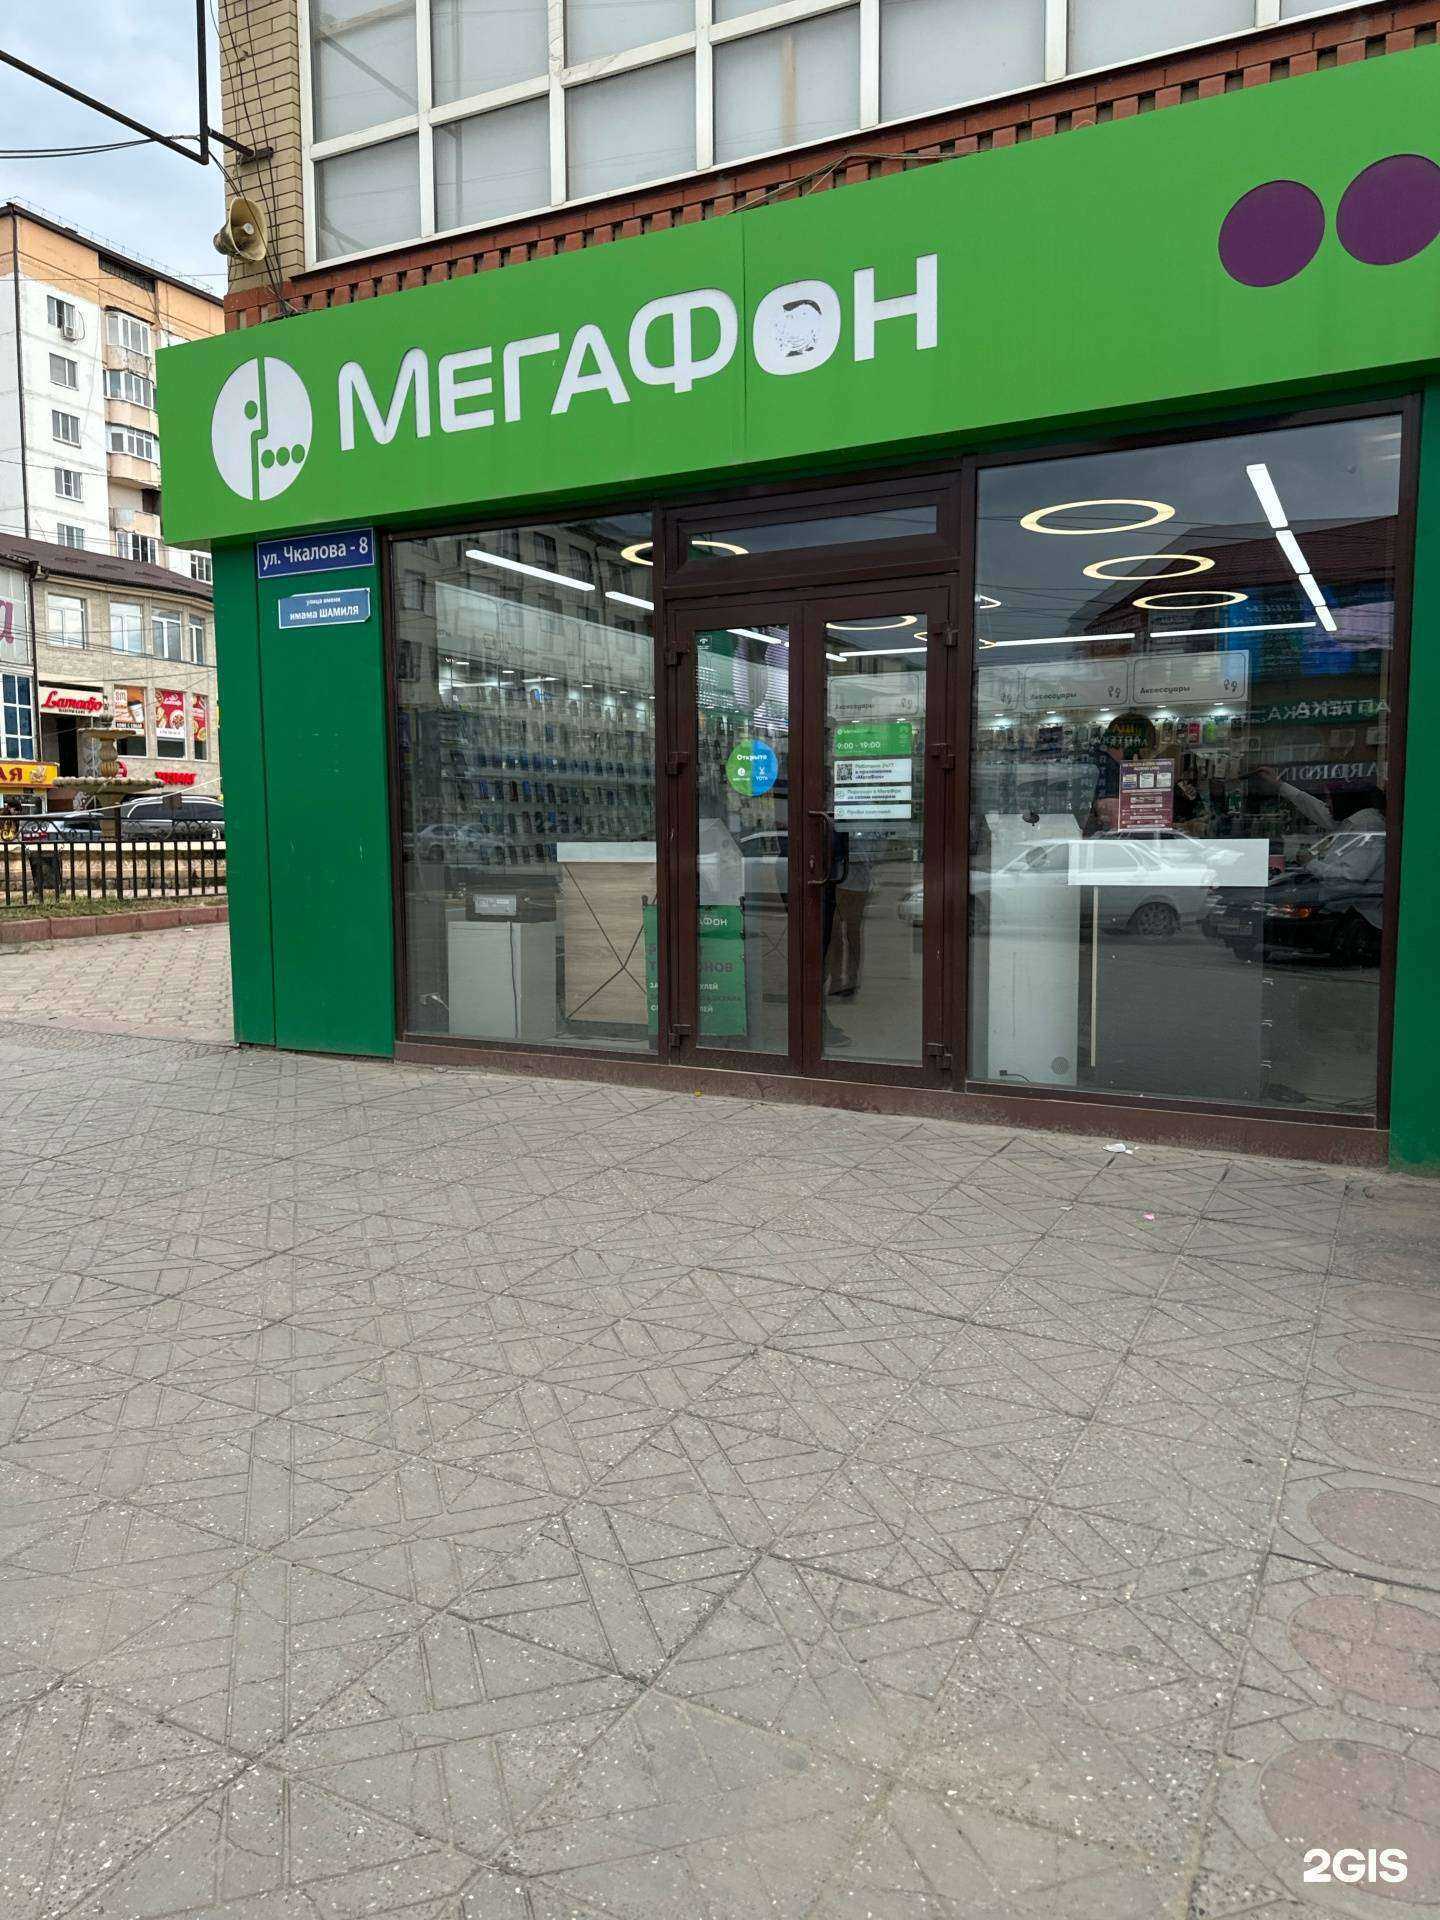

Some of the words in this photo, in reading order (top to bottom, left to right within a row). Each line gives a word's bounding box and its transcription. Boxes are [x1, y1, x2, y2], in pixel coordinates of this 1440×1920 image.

[338, 253, 938, 452] МЕГАФОН
[262, 553, 281, 569] ул.
[284, 543, 347, 563] Чкалова
[359, 536, 368, 554] 8
[290, 611, 317, 620] имама
[319, 605, 359, 618] ШАМИЛЯ
[1139, 686, 1191, 696] Аксессуары
[837, 742, 853, 750] 9:00
[860, 740, 881, 749] 19:00
